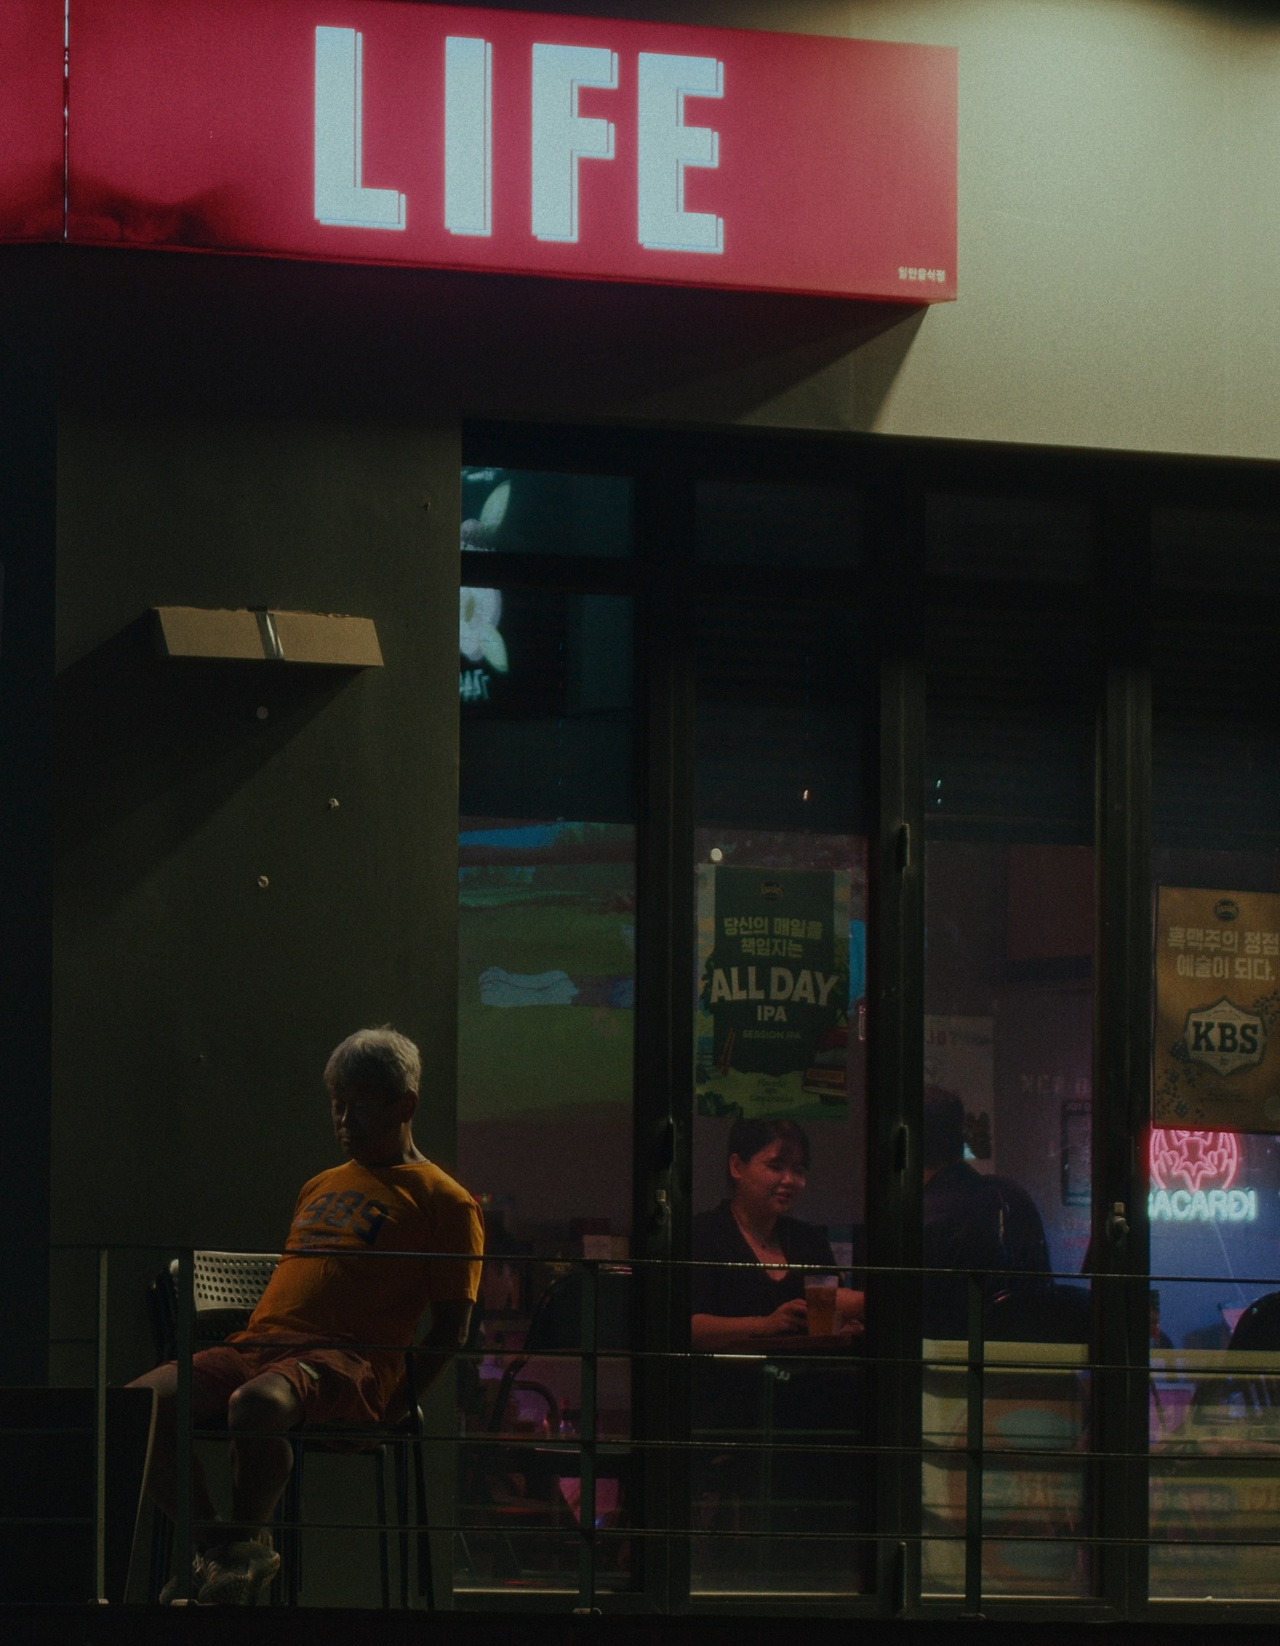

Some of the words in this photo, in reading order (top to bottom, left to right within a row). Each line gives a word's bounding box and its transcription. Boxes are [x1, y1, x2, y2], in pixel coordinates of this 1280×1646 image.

[312, 25, 726, 256] LIFE
[723, 916, 769, 937] 당신의
[773, 918, 823, 941] 매일을
[1166, 926, 1239, 954] 흑맥주의
[740, 937, 804, 958] 책임지는
[710, 965, 765, 1004] ALL
[770, 966, 841, 1007] DAY
[756, 1005, 788, 1023] IPA
[742, 1029, 784, 1040] SESSION
[1191, 1020, 1259, 1054] KBS
